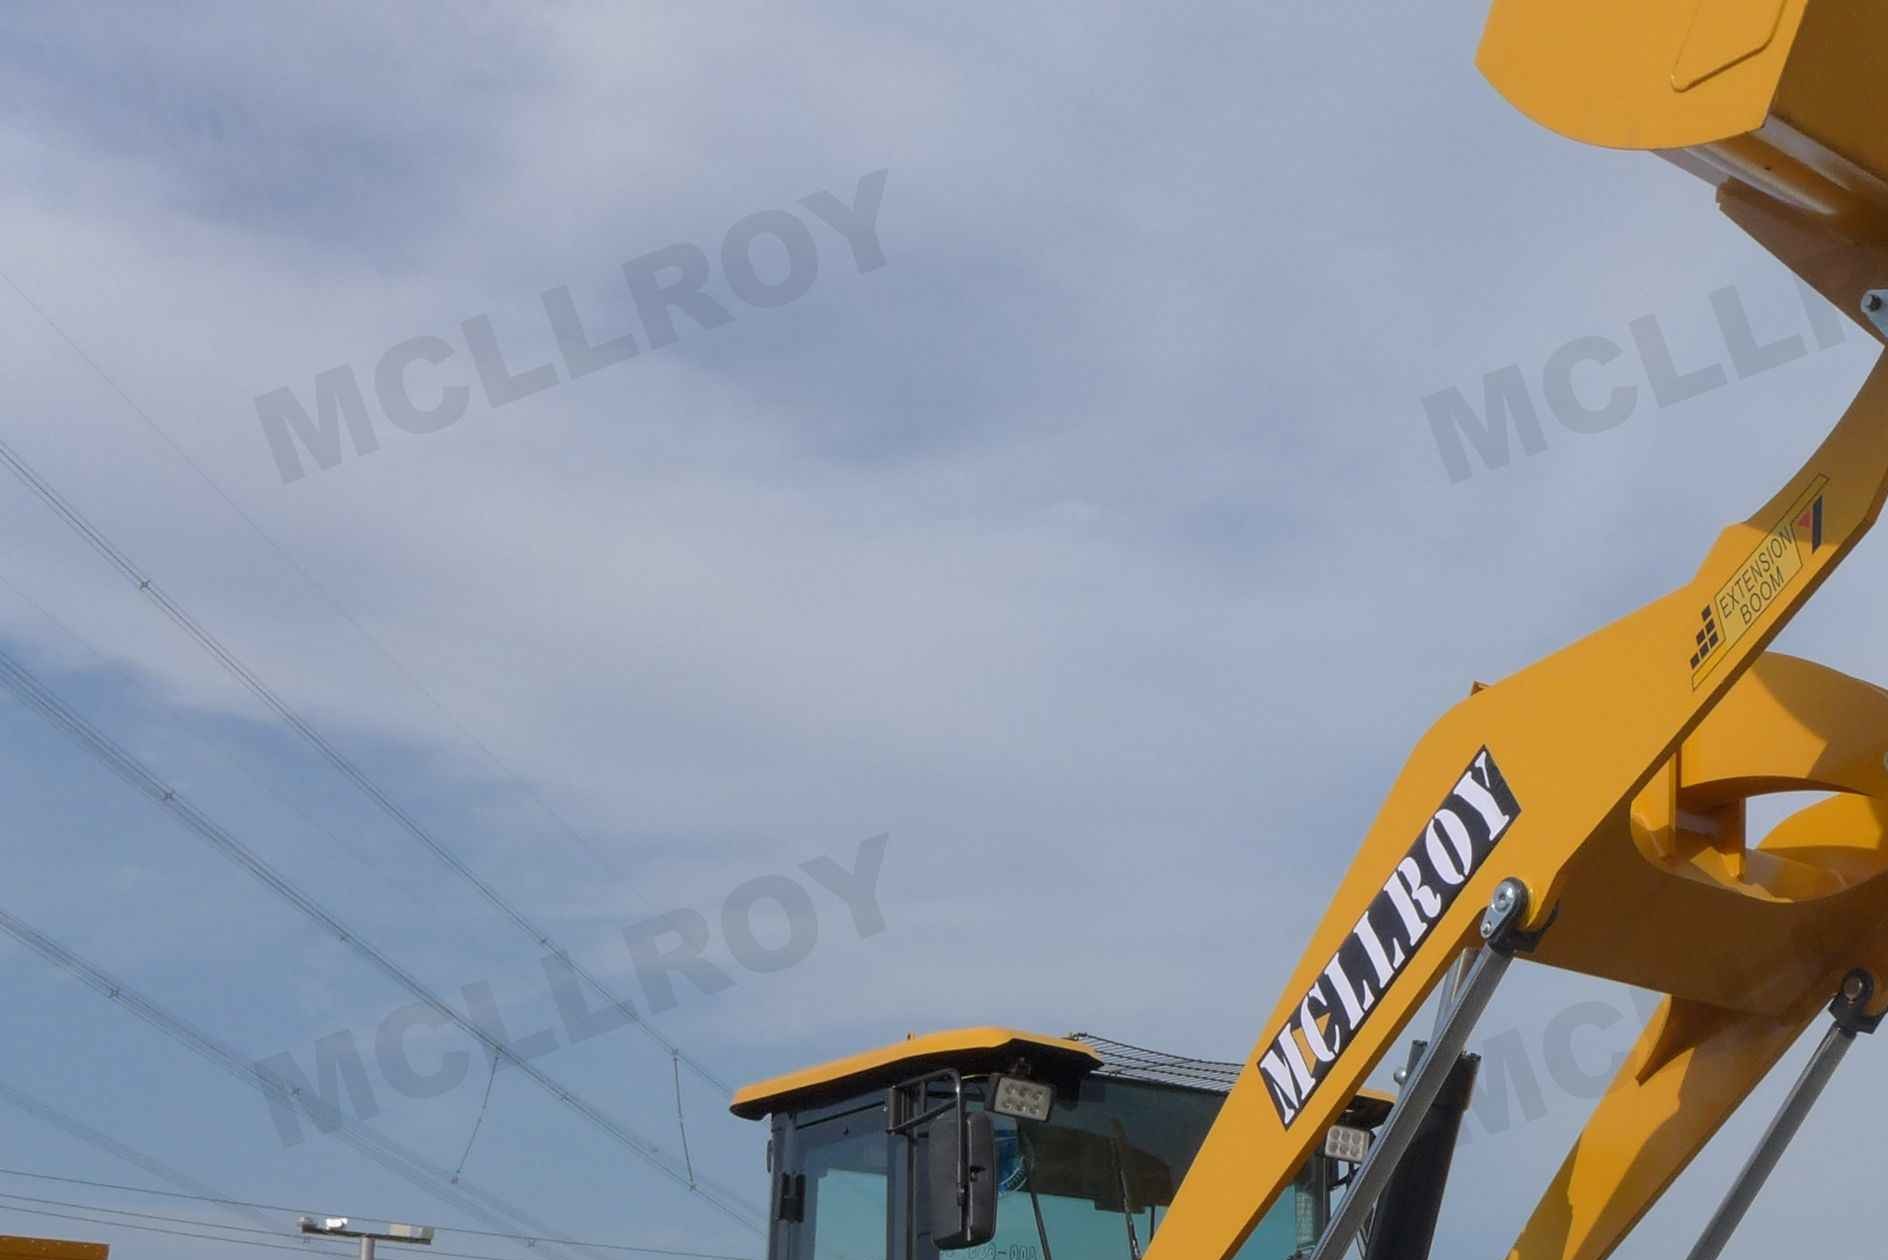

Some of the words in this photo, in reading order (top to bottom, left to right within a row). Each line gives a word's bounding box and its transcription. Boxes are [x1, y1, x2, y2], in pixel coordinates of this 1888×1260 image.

[1718, 525, 1793, 618] EXTENSION
[1739, 566, 1785, 625] BOOM
[1259, 750, 1510, 1125] MCLLROY
